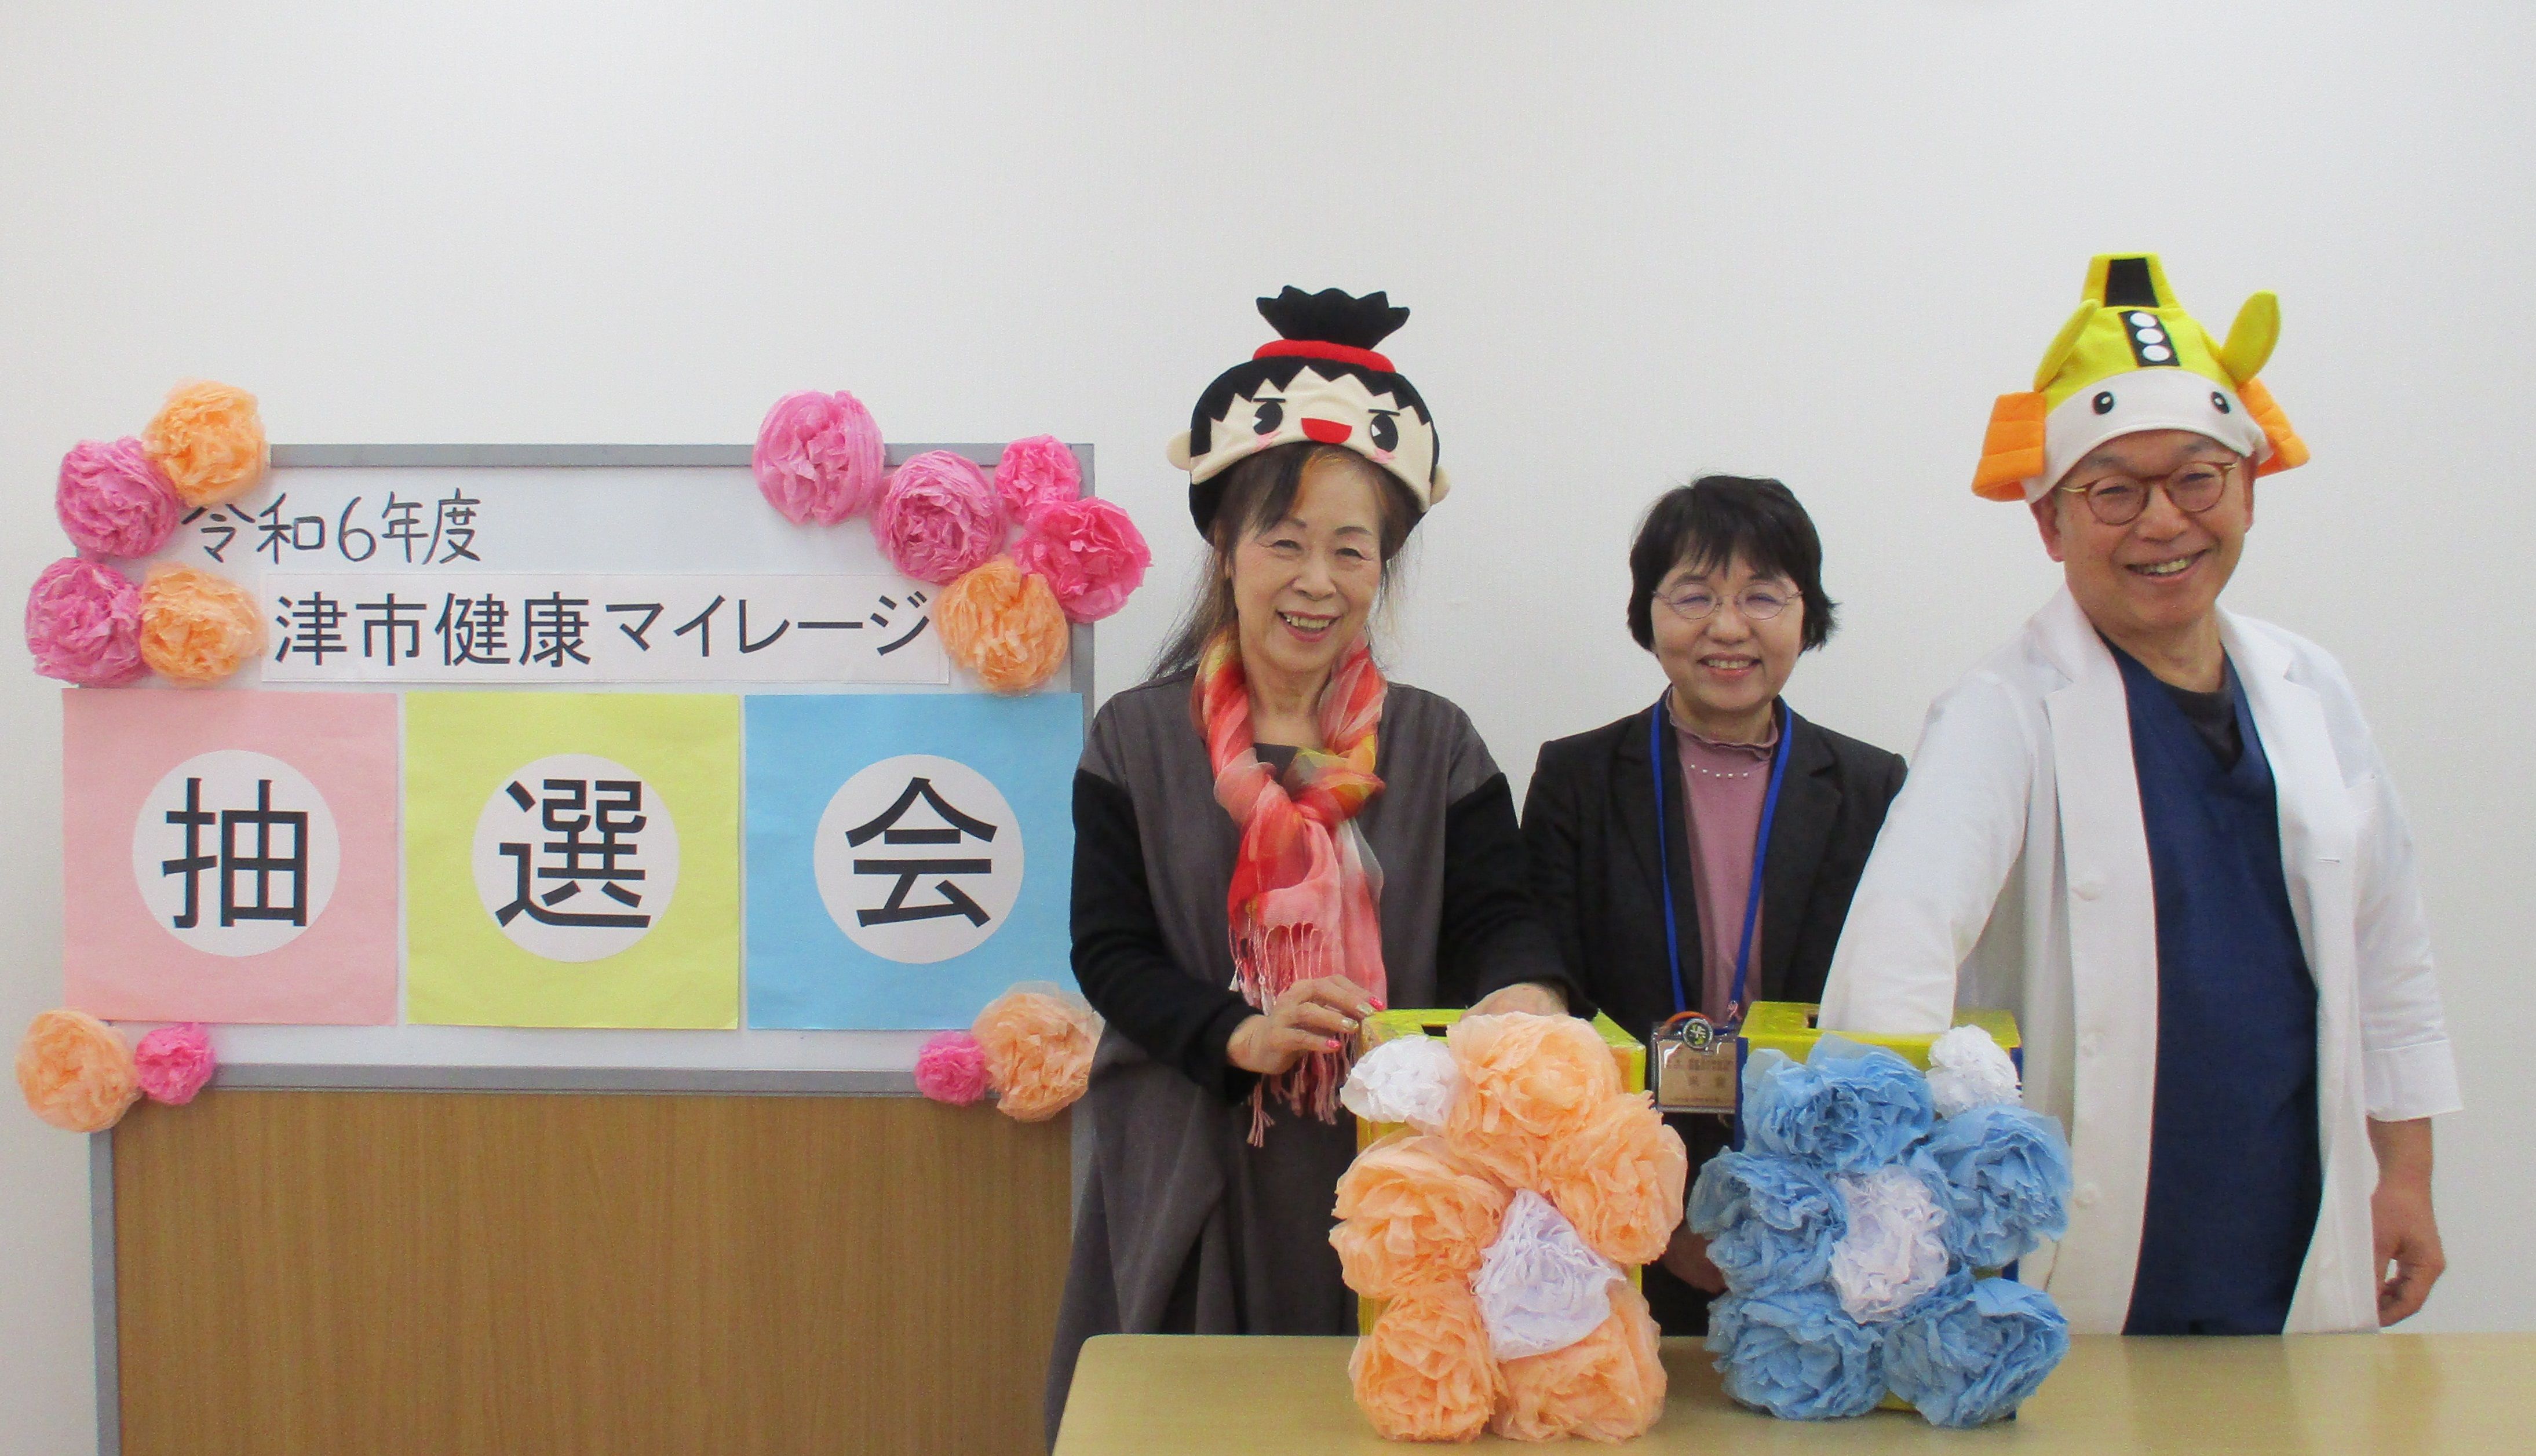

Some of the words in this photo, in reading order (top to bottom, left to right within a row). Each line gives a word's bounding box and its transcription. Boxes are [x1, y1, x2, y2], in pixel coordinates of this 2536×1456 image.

[181, 487, 481, 565] 令和6年度
[275, 590, 930, 668] 津市健康マイレージ
